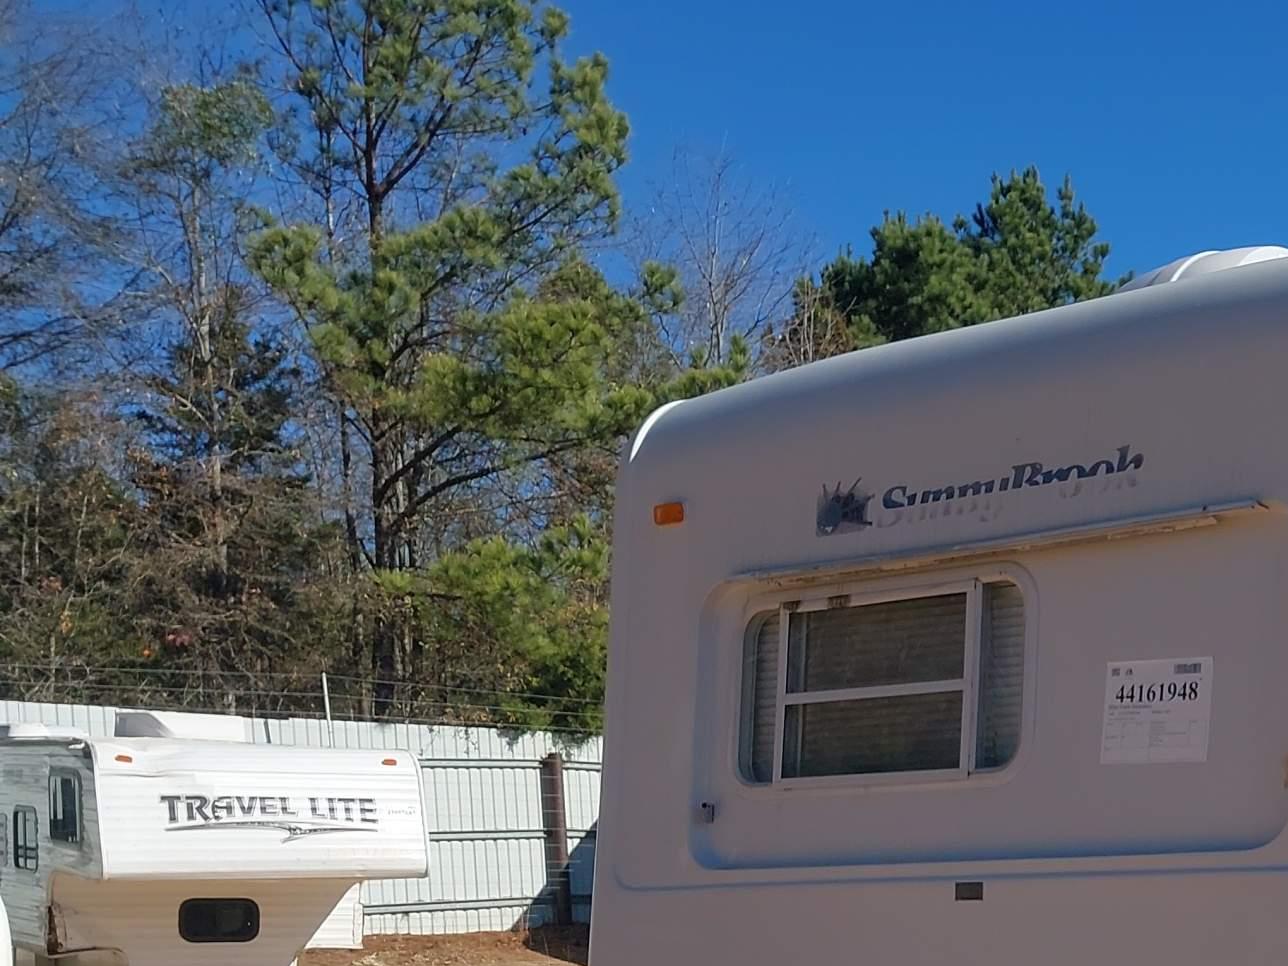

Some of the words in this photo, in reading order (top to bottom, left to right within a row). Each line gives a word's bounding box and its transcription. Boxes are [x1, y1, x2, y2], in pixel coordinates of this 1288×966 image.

[1115, 680, 1199, 704] 44161948
[160, 794, 298, 824] TRAVEL
[308, 797, 379, 823] LITE
